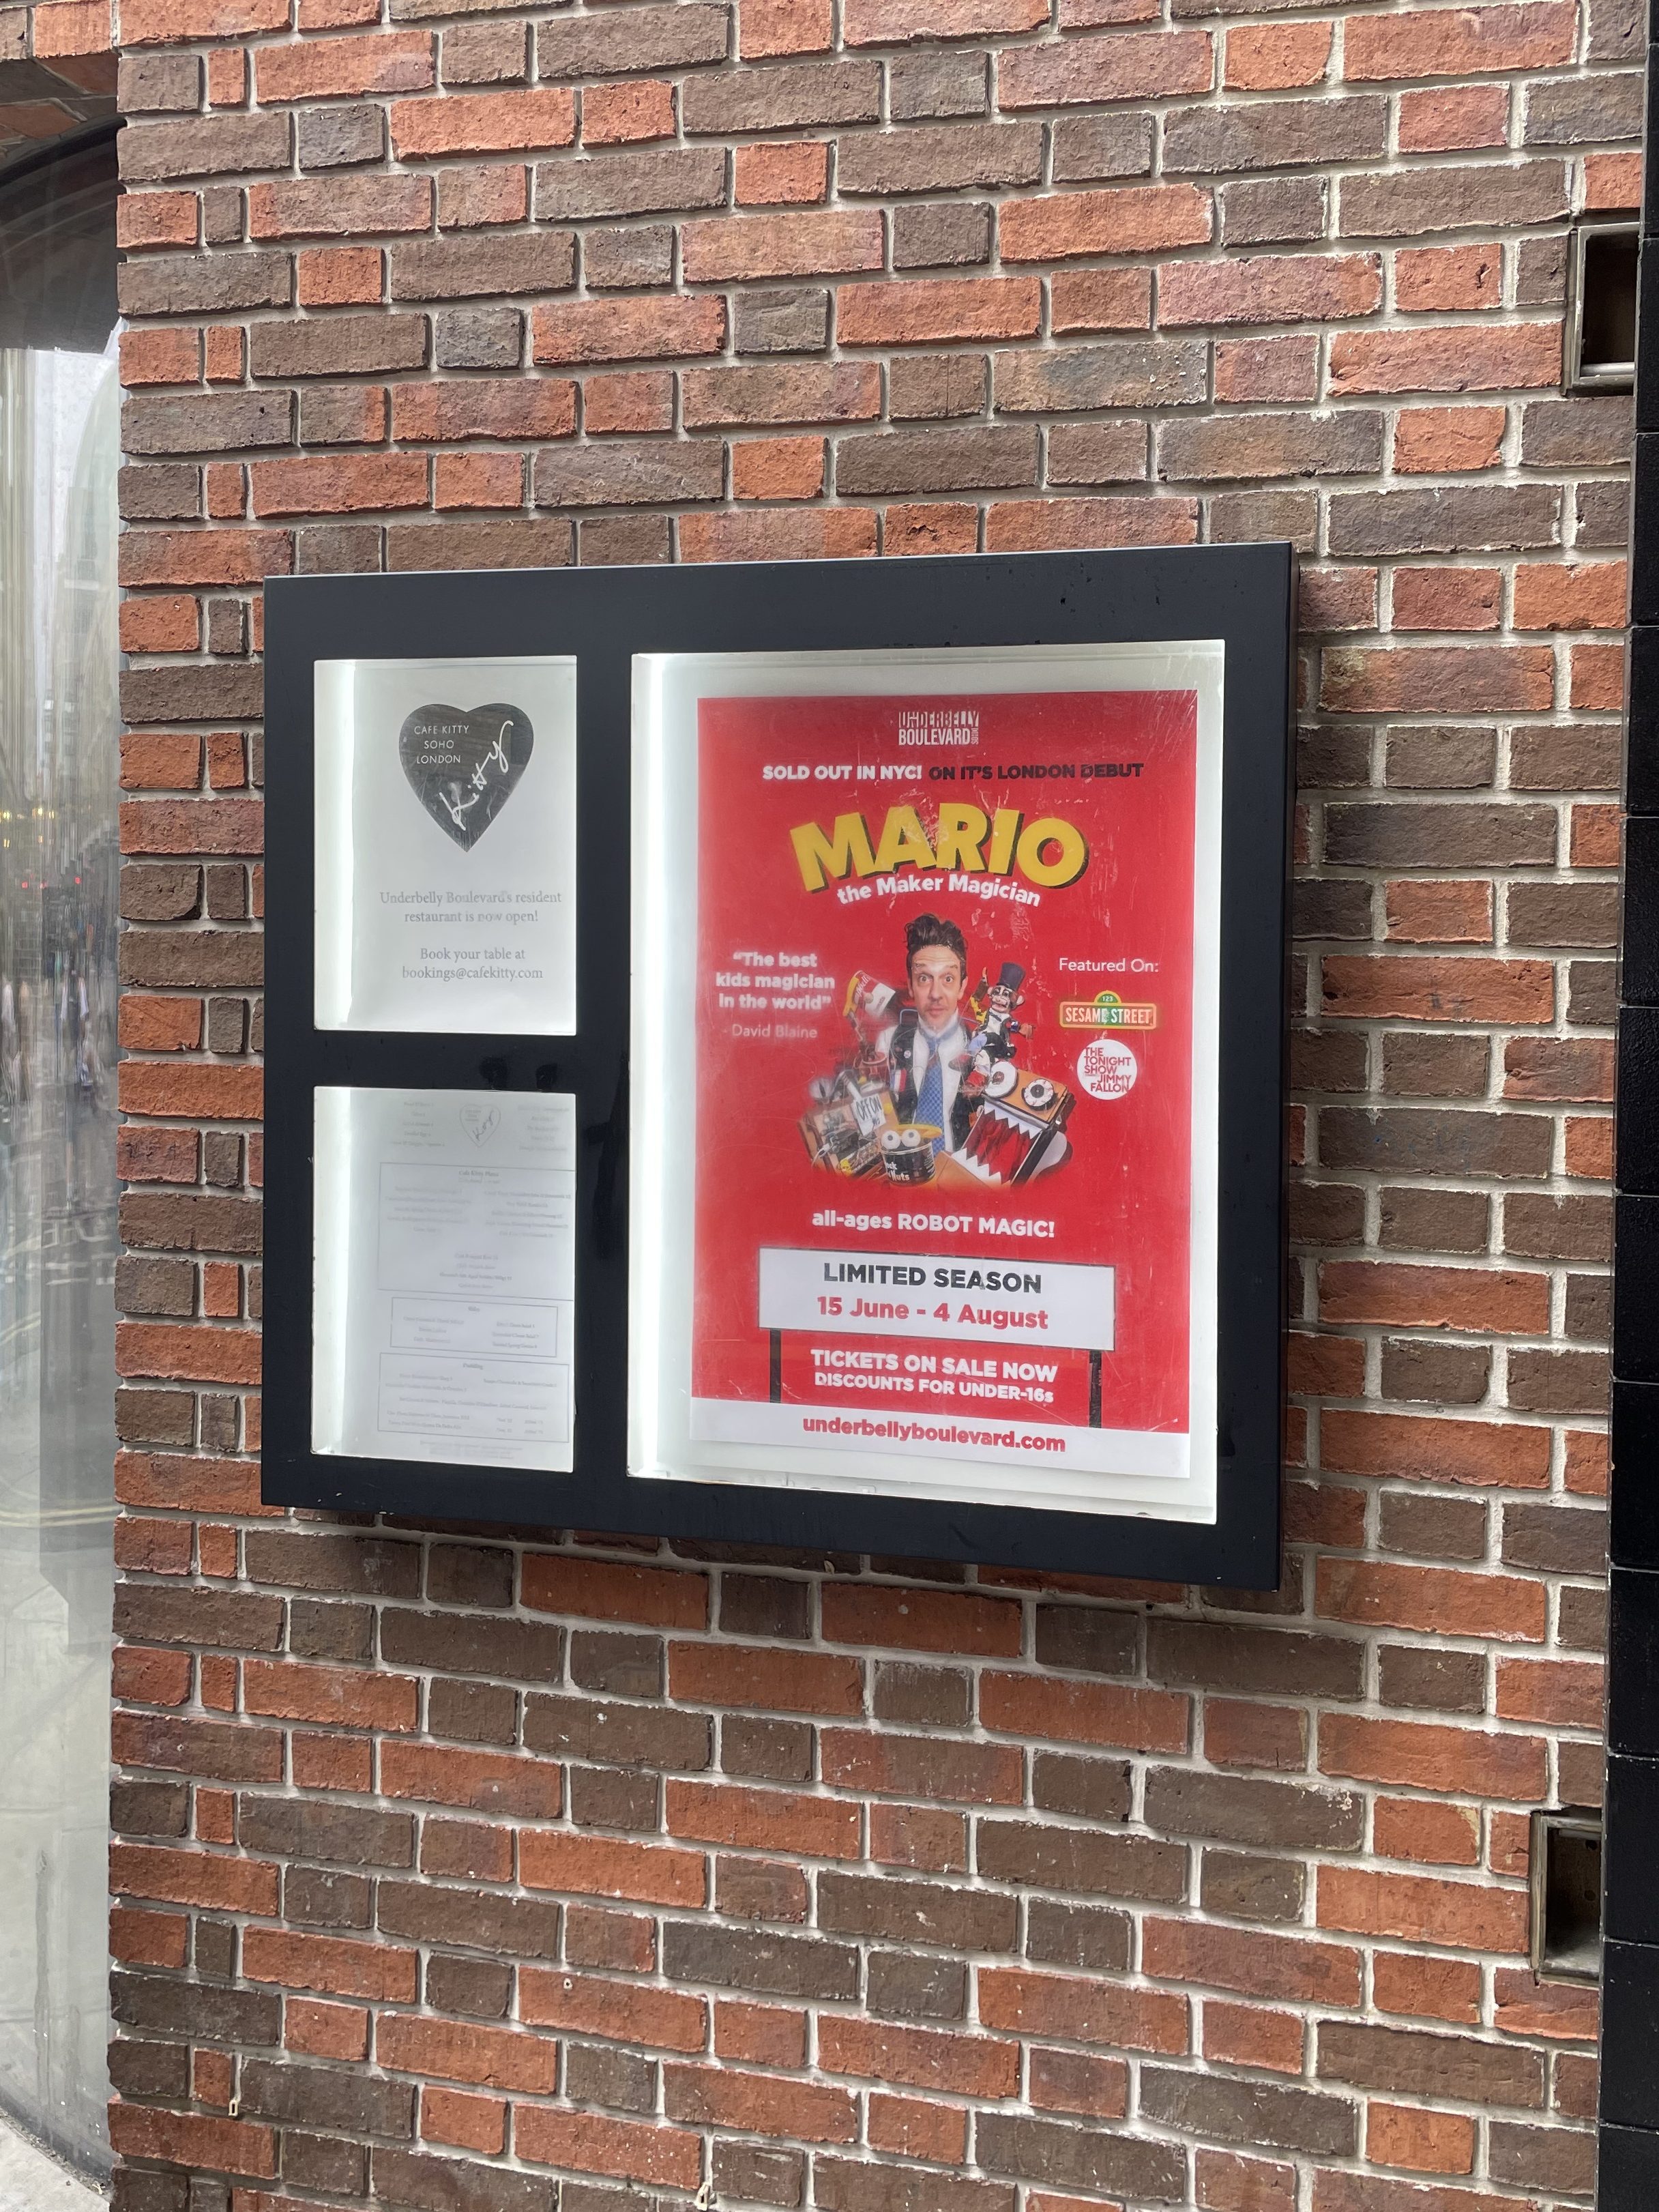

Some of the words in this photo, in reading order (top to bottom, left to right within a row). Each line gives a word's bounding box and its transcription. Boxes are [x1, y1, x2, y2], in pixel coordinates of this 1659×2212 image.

[414, 725, 438, 735] CAFE
[442, 725, 469, 734] KITTY
[898, 728, 971, 745] BOULEVARD
[424, 740, 454, 749] SOHO
[417, 755, 461, 764] LONDON
[763, 765, 810, 780] SOLD
[814, 765, 853, 780] OUT
[857, 766, 875, 780] IN
[880, 765, 922, 780] NYC!
[928, 766, 956, 781] ON
[960, 766, 993, 780] IT'S
[998, 764, 1076, 780] LONDON
[1081, 763, 1145, 778] DEBUT
[790, 802, 1089, 894] MARIO
[837, 885, 872, 905] the
[877, 874, 944, 897] Maker
[949, 873, 1041, 907] Magician
[379, 890, 443, 907] Underbelly
[515, 890, 562, 903] resident
[405, 911, 462, 922] restaurant
[466, 910, 474, 922] is
[478, 912, 502, 922] now
[505, 910, 538, 925] open!
[420, 947, 452, 960] Book
[454, 950, 481, 963] your
[484, 947, 512, 960] table
[514, 949, 525, 960] at
[778, 952, 818, 967] best
[1059, 957, 1126, 972] Featured
[1130, 958, 1160, 973] On:
[402, 965, 544, 983] bookings@cafekitty.com
[716, 972, 751, 987] kids
[754, 973, 836, 991] magician
[718, 993, 735, 1008] in
[739, 993, 767, 1009] the
[1065, 1006, 1109, 1023] SESAME
[1111, 1008, 1153, 1024] STREET
[731, 1023, 771, 1037] David
[775, 1024, 818, 1038] Blaine
[1084, 1047, 1104, 1057] THE
[1084, 1056, 1132, 1066] TONIGHT
[1084, 1065, 1117, 1075] SHOW
[1090, 1082, 1130, 1092] FALLON
[1098, 1075, 1132, 1083] JIMMY
[812, 1210, 892, 1231] all-ages
[898, 1213, 973, 1233] ROBOT
[978, 1217, 1055, 1238] MAGIC!
[823, 1262, 926, 1286] LIMITED
[934, 1268, 1042, 1294] SEASON
[817, 1296, 842, 1316] 15
[849, 1298, 909, 1320] June
[933, 1303, 950, 1322] 4
[958, 1304, 1048, 1330] August
[810, 1349, 899, 1371] TICKETS
[904, 1354, 937, 1373] ON
[941, 1357, 997, 1378] SALE
[1002, 1362, 1058, 1382] NOW
[814, 1372, 914, 1392] DISCOUNTS
[918, 1379, 955, 1395] FOR
[959, 1382, 1054, 1403] UNDER-16s
[803, 1417, 1066, 1453] underbellyboulevard.com
